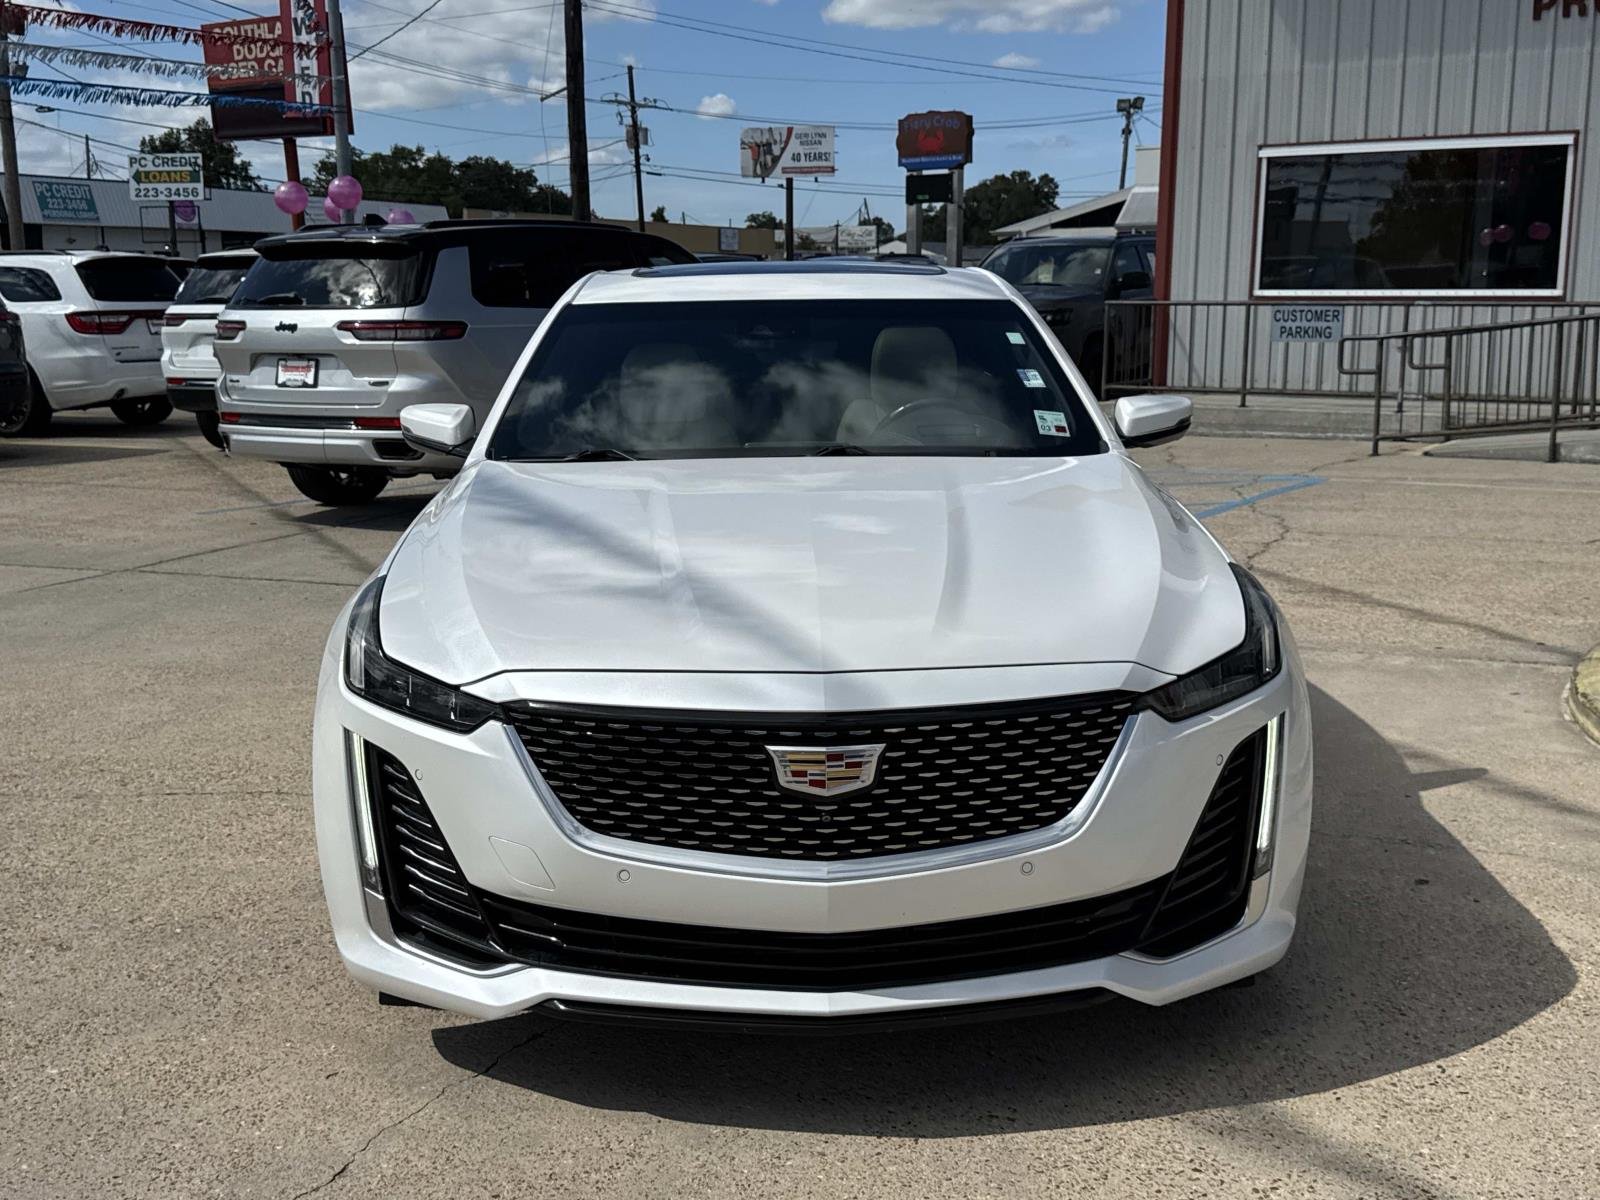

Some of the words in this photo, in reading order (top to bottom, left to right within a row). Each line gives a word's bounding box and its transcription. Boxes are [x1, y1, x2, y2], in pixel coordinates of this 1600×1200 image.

[129, 156, 147, 168] PC
[152, 155, 200, 168] CREDIT
[791, 152, 801, 162] 40
[141, 171, 191, 182] LOANS
[34, 182, 51, 196] PC
[52, 184, 90, 199] CREDIT
[1273, 309, 1340, 323] CUSTOMER
[274, 321, 298, 333] Jeep
[1279, 326, 1332, 339] PARKING
